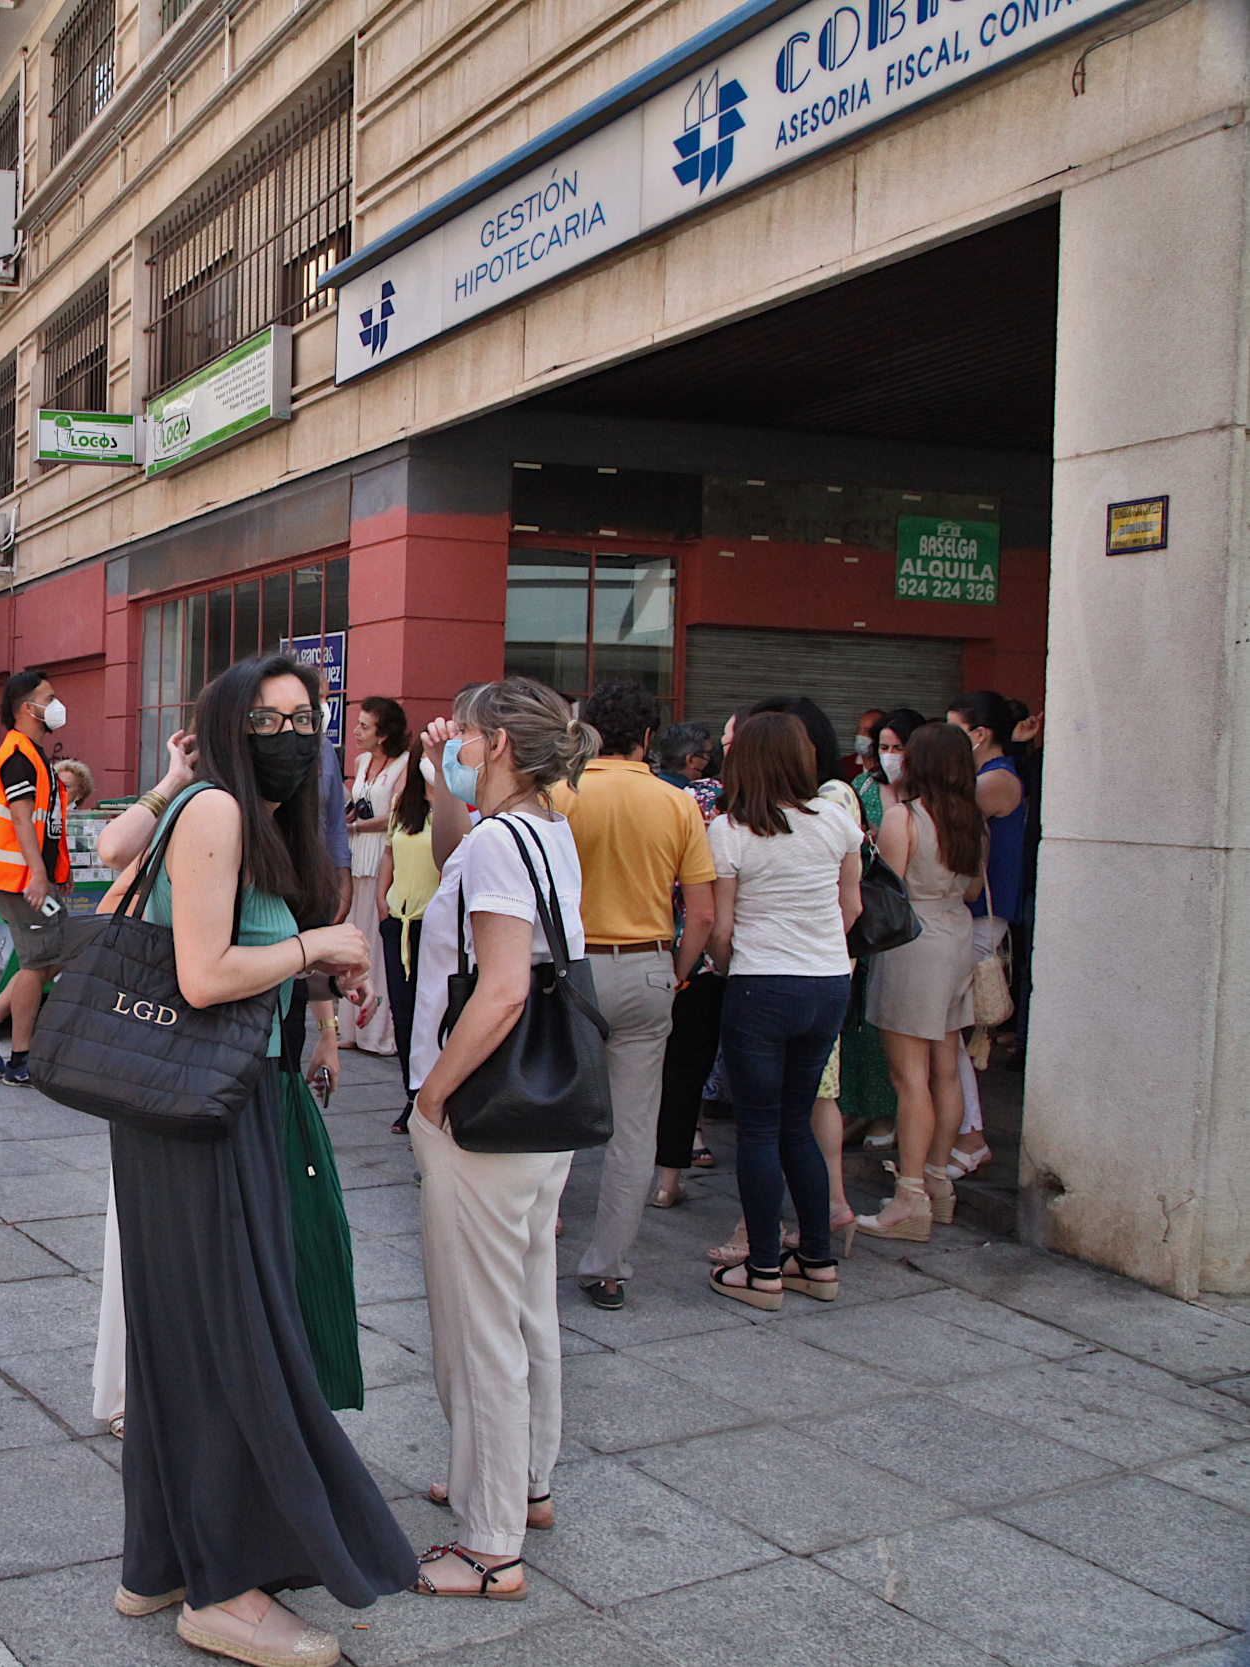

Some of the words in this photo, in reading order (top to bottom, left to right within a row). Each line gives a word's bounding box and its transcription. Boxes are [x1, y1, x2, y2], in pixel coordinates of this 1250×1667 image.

[775, 78, 871, 150] ASESORIA
[886, 30, 971, 96] FISCAL,
[480, 167, 578, 248] GESTIÓN
[454, 201, 606, 302] HIPOTECARIA
[71, 435, 118, 448] LOGOS
[161, 416, 191, 449] LOGOS
[919, 534, 978, 560] BASELGA
[900, 558, 995, 581] ALQUILA
[898, 578, 928, 596] 924
[932, 580, 961, 599] 224
[966, 582, 995, 601] 326
[301, 645, 335, 664] garca&
[112, 991, 178, 1026] LGD
